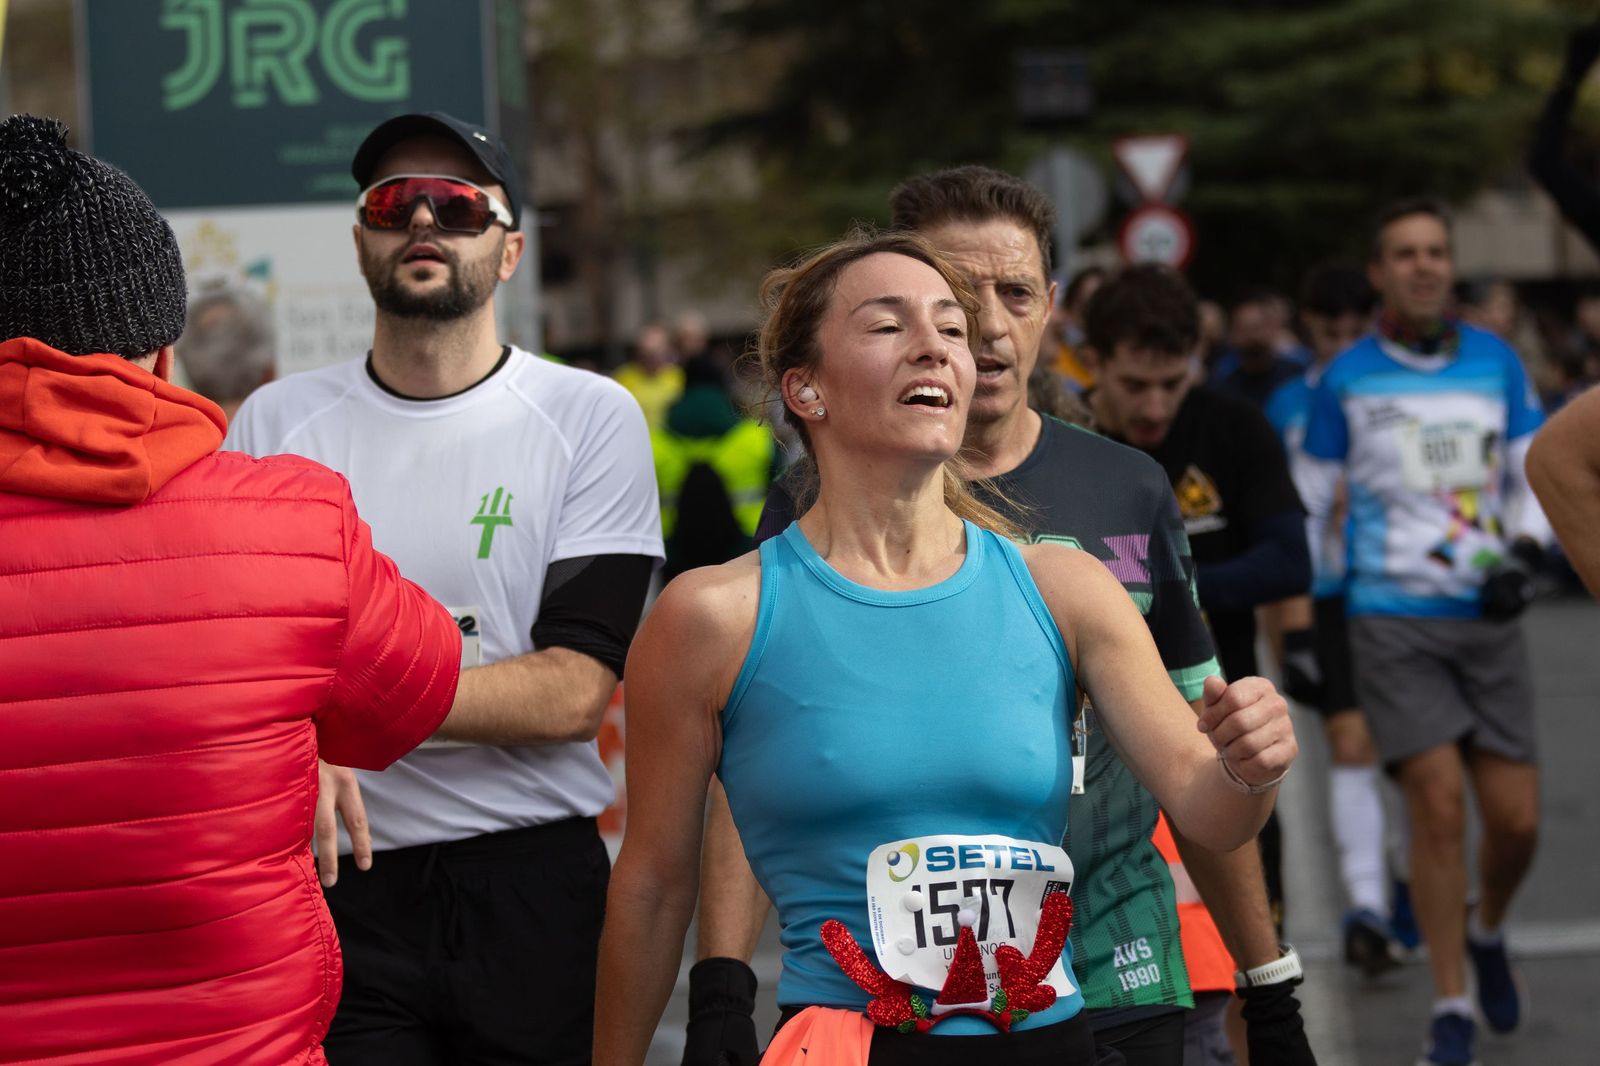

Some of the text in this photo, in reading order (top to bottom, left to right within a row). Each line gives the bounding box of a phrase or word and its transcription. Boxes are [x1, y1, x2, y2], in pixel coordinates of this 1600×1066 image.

[161, 0, 410, 109] JRG
[926, 844, 1055, 872] SETEL
[911, 878, 1016, 949] 1577
[1114, 937, 1152, 967] AVS
[1118, 963, 1161, 992] 1990
